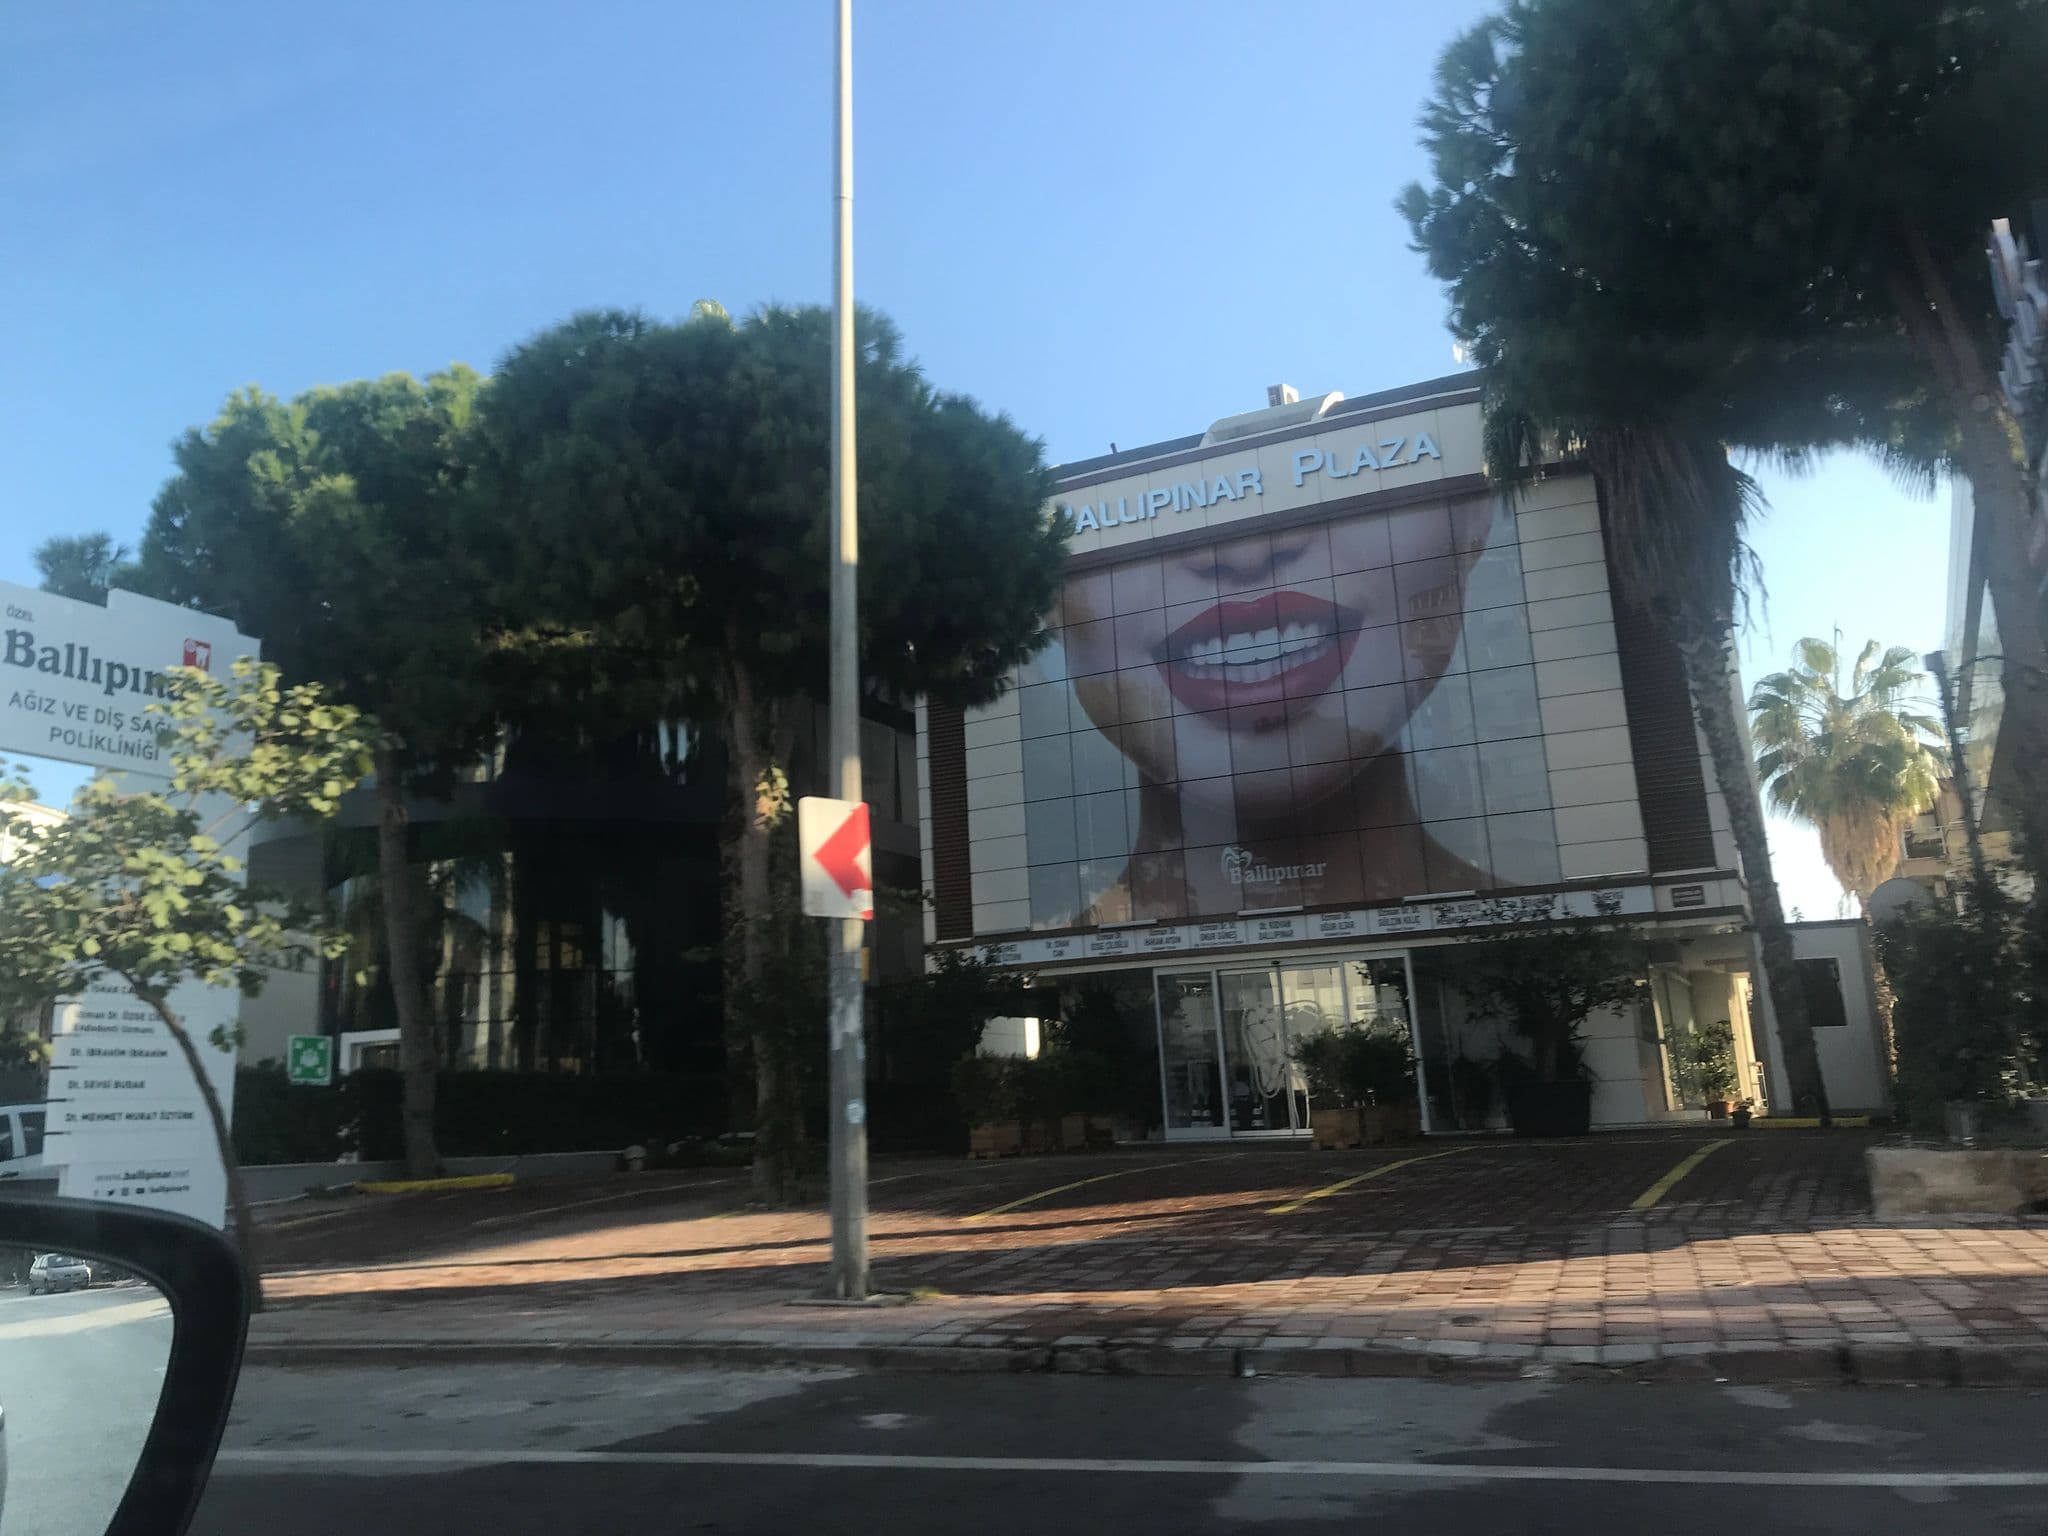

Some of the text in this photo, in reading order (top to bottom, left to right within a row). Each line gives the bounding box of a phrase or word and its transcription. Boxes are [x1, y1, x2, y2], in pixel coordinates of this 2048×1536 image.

[1064, 431, 1441, 534] ALLIPINAR PLAZA
[5, 603, 34, 623] ÖZEL
[3, 628, 186, 703] Ballıpın
[8, 690, 56, 715] AĞIZ
[62, 701, 89, 721] VE
[94, 707, 124, 732] DİŞ
[49, 726, 160, 761] POLİKLİNİĞİ
